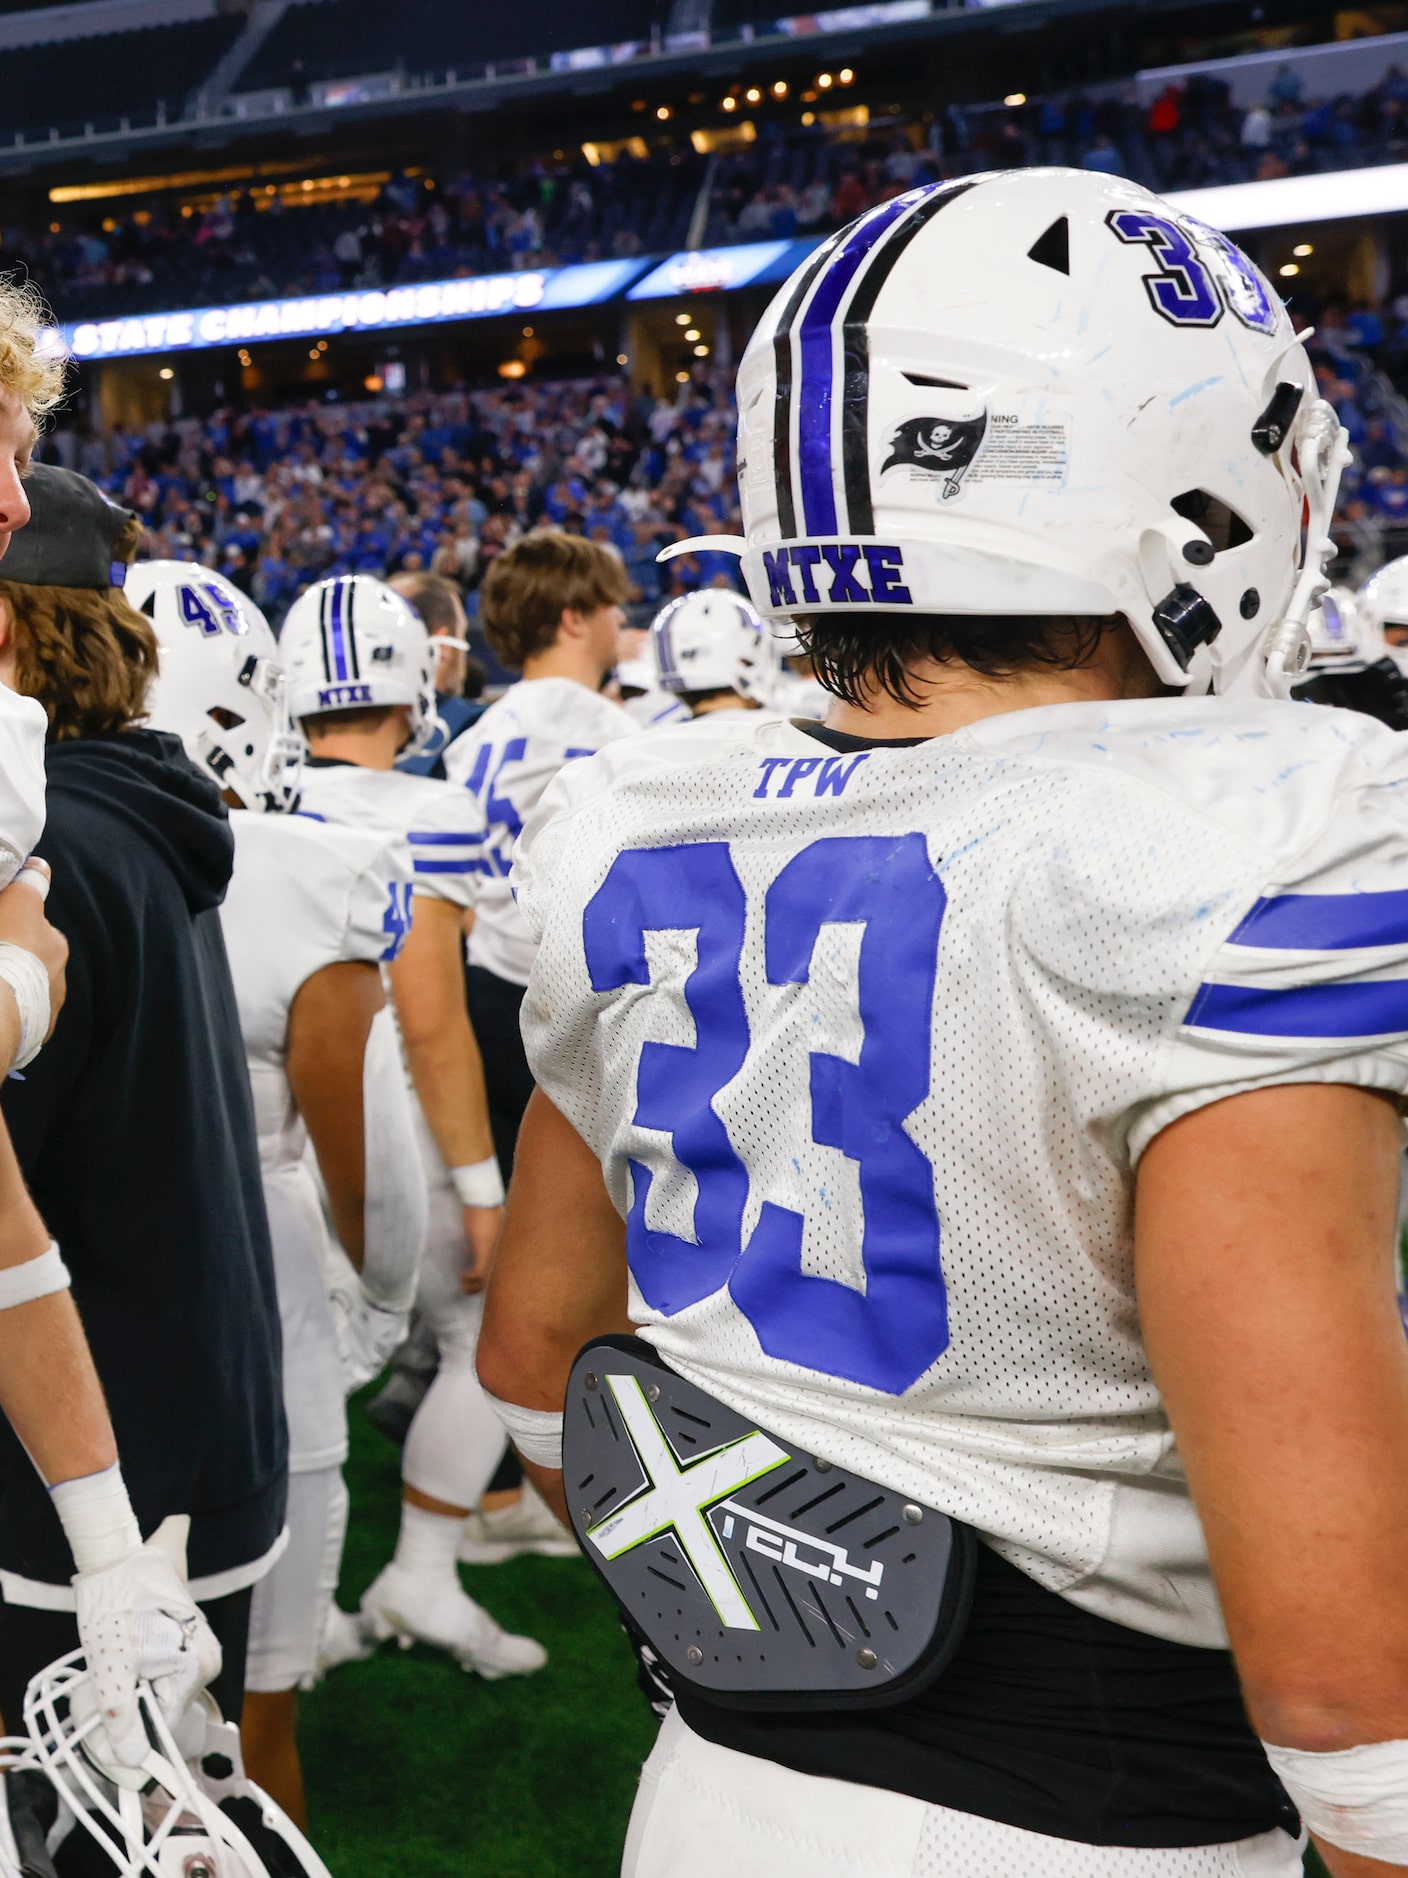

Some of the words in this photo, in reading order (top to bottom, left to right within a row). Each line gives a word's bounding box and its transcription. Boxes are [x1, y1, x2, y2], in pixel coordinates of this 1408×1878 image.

[72, 313, 194, 356] STATE
[199, 273, 545, 343] CHAMPIONSHIPS
[1104, 209, 1279, 337] 33
[762, 544, 914, 608] MTXE
[752, 753, 870, 799] TPW
[582, 832, 950, 1397] 33
